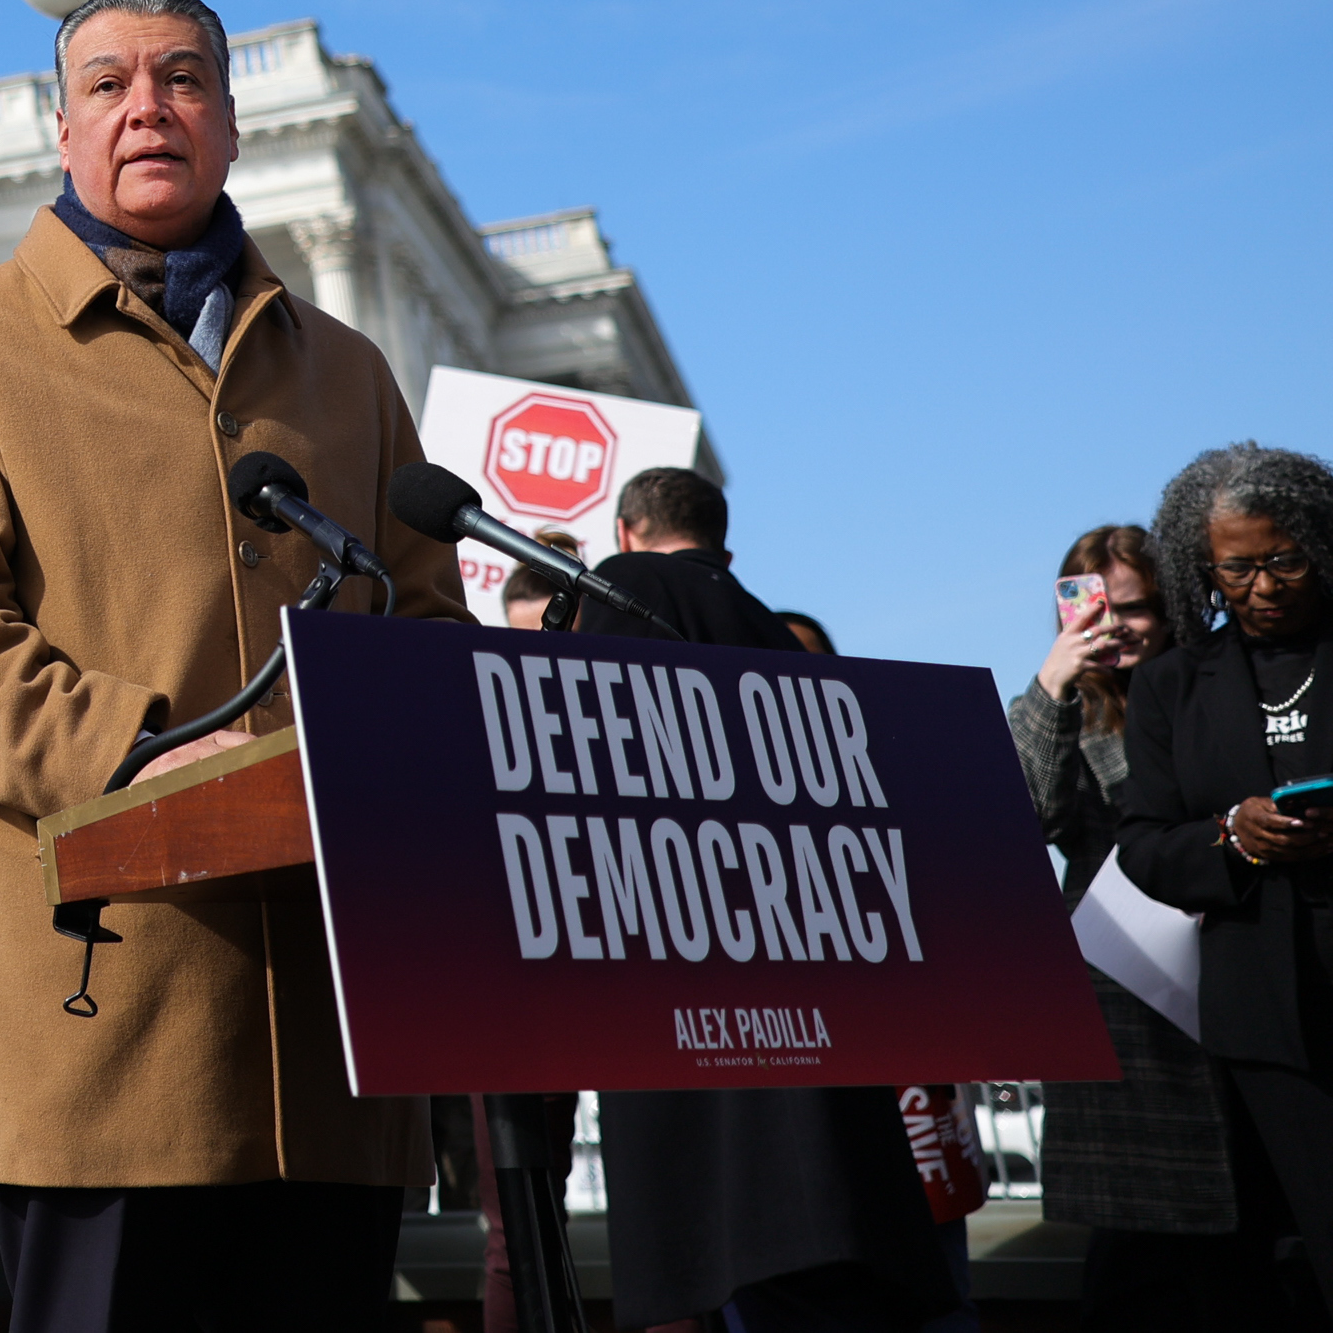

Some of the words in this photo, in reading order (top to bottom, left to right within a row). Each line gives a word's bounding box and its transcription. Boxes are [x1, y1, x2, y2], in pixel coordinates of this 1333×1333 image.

[499, 427, 604, 483] STOP
[472, 651, 735, 801] DEFEND
[738, 671, 888, 807] OUR
[496, 813, 924, 963] DEMOCRACY
[674, 1008, 734, 1049] ALEX
[734, 1008, 832, 1049] PADILLA
[696, 1058, 711, 1066] U.S.
[715, 1057, 753, 1066] SENATOR
[770, 1056, 821, 1065] CALIFORNIA
